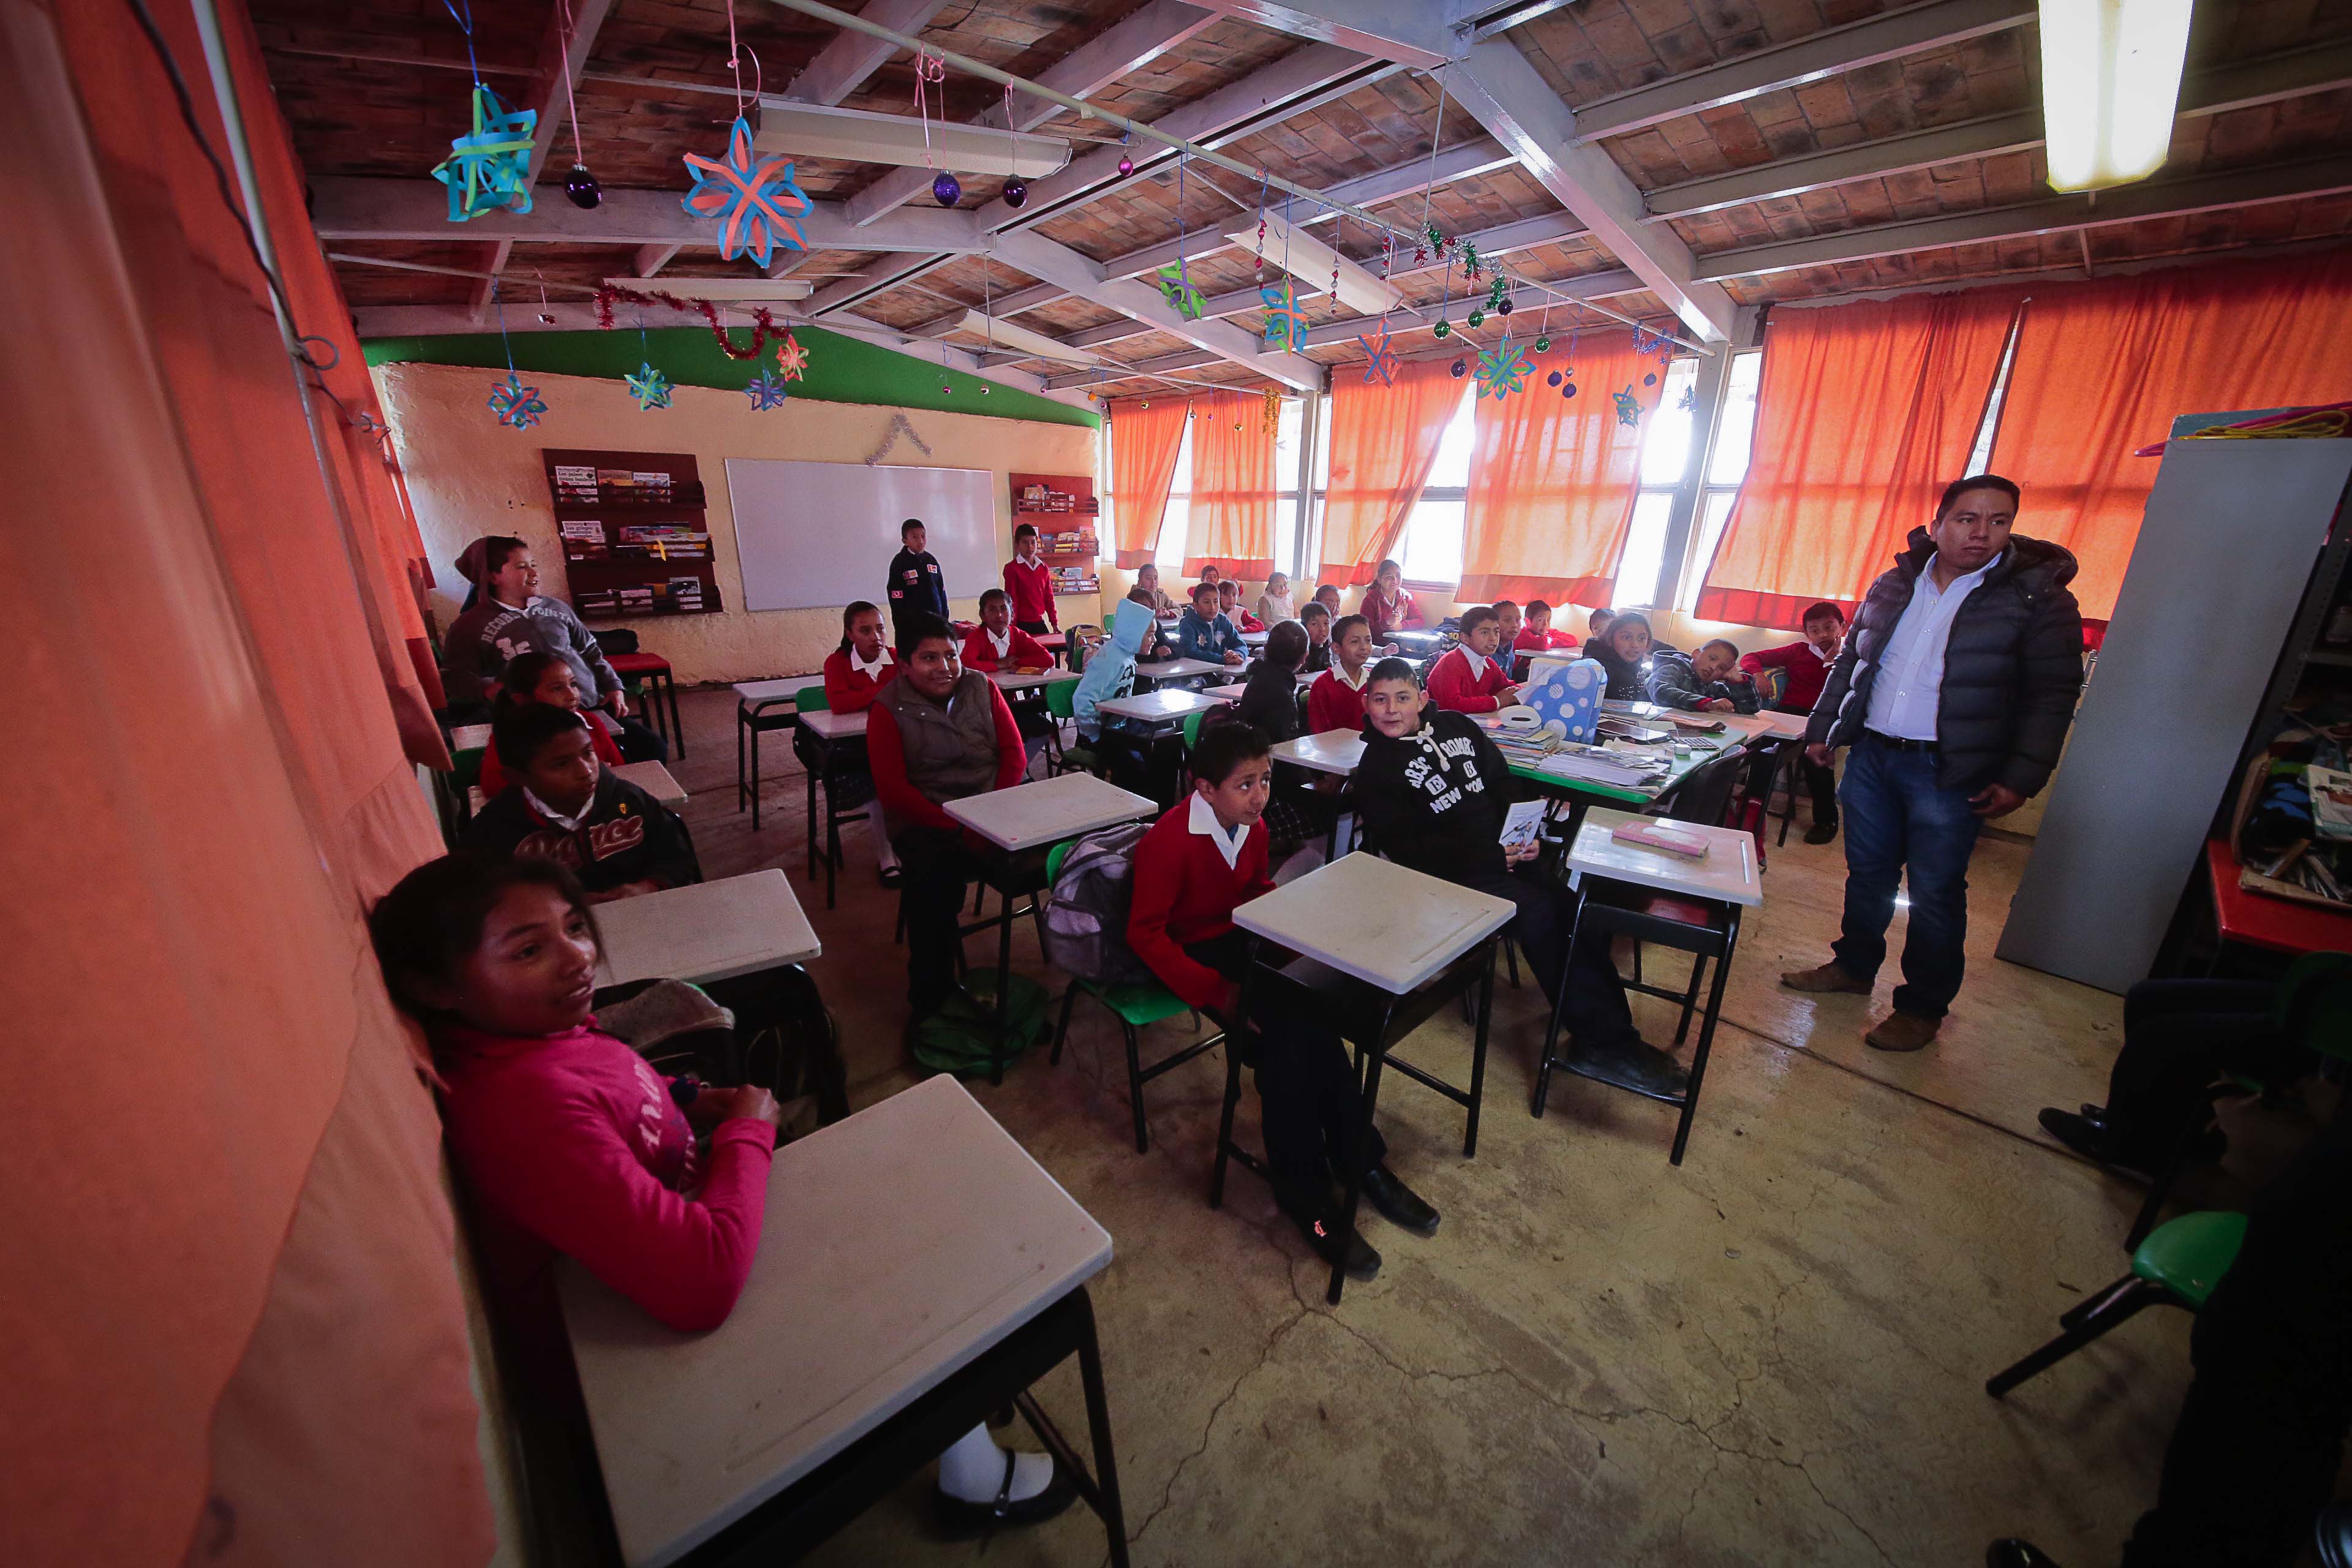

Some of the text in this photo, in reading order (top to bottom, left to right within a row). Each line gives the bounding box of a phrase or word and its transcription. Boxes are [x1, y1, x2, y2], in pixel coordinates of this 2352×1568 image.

[1427, 762, 1476, 793] E B
[1430, 787, 1462, 814] NEW
